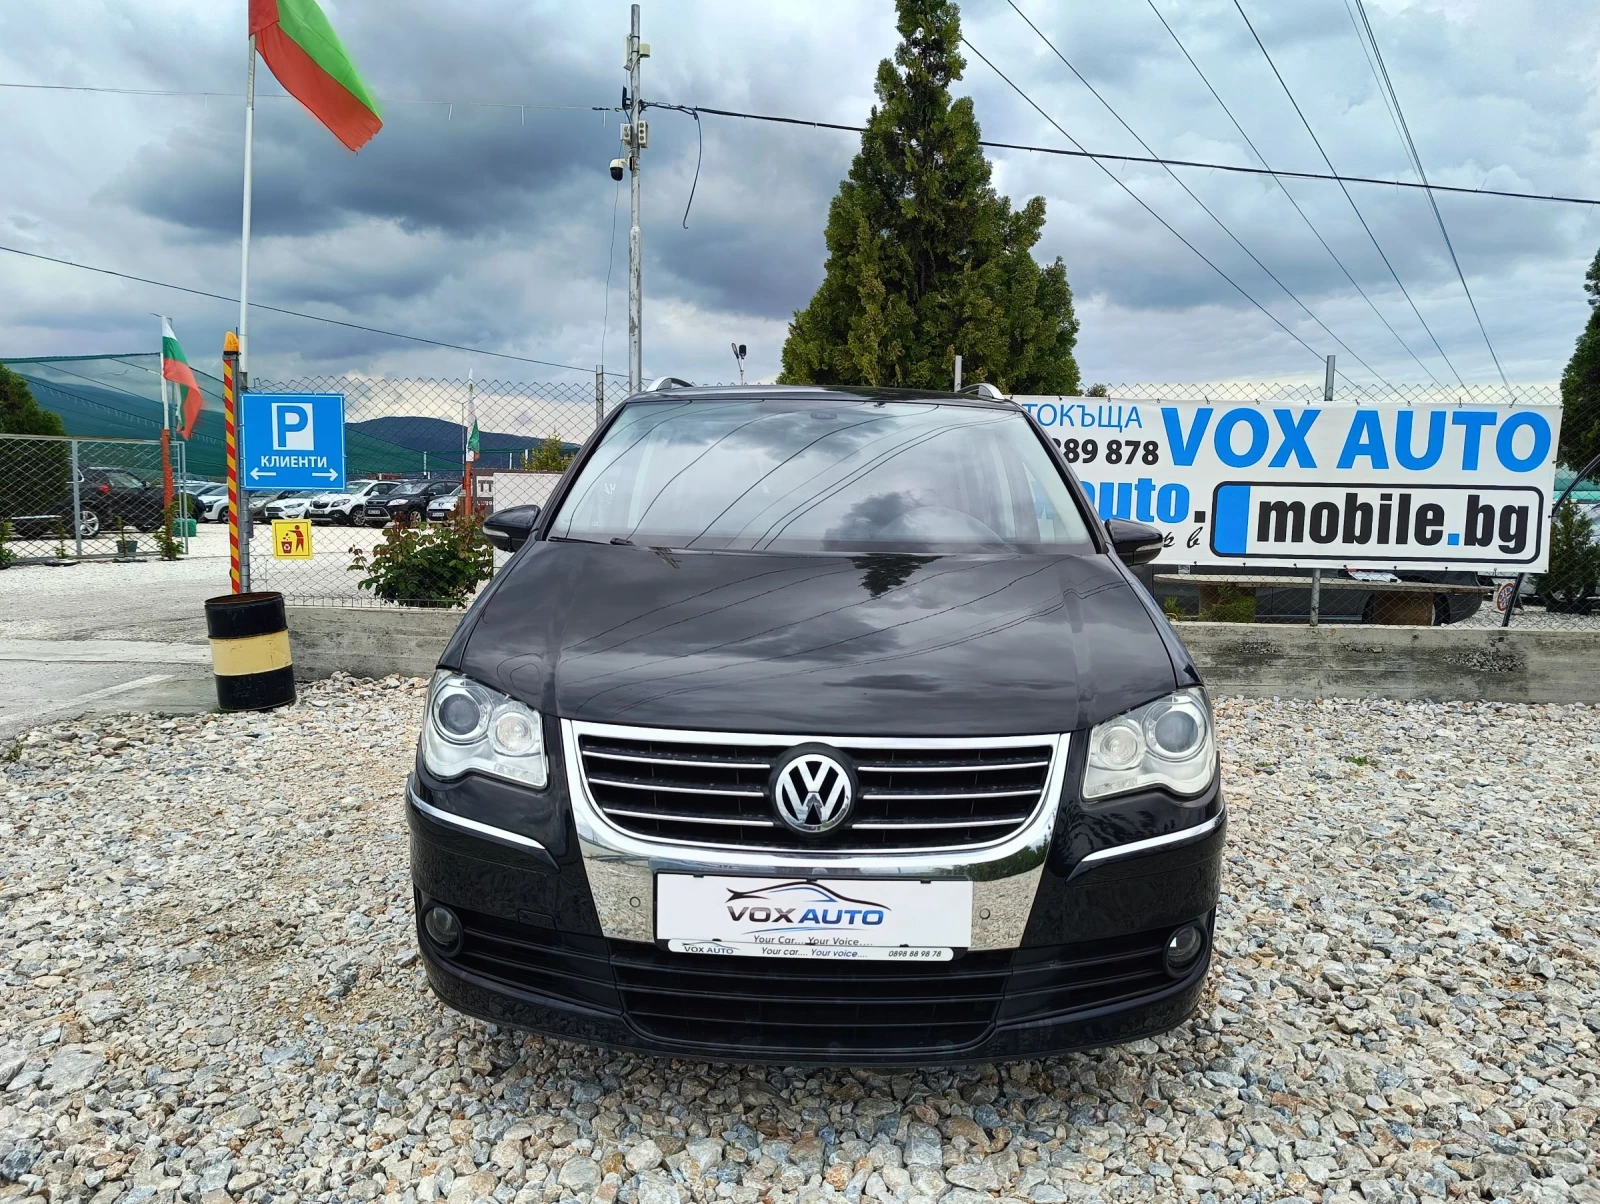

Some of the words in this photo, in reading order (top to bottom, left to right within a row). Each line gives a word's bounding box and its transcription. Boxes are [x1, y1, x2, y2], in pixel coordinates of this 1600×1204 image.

[277, 406, 308, 447] P
[1160, 406, 1321, 470] VOX
[1336, 409, 1552, 473] AUTO
[1052, 437, 1099, 464] 89
[1105, 439, 1160, 466] 878
[261, 455, 328, 468] КЛИЕНТИ
[1256, 492, 1530, 554] mobile.bg
[753, 935, 775, 944] Your
[807, 936, 830, 945] Your
[684, 946, 705, 954] VOX
[706, 947, 734, 955] AUTO
[761, 947, 782, 955] Your
[811, 948, 832, 957] Your
[888, 950, 908, 958] 0898
[908, 950, 919, 958] 88
[920, 950, 931, 958] 98
[931, 950, 942, 958] 78
